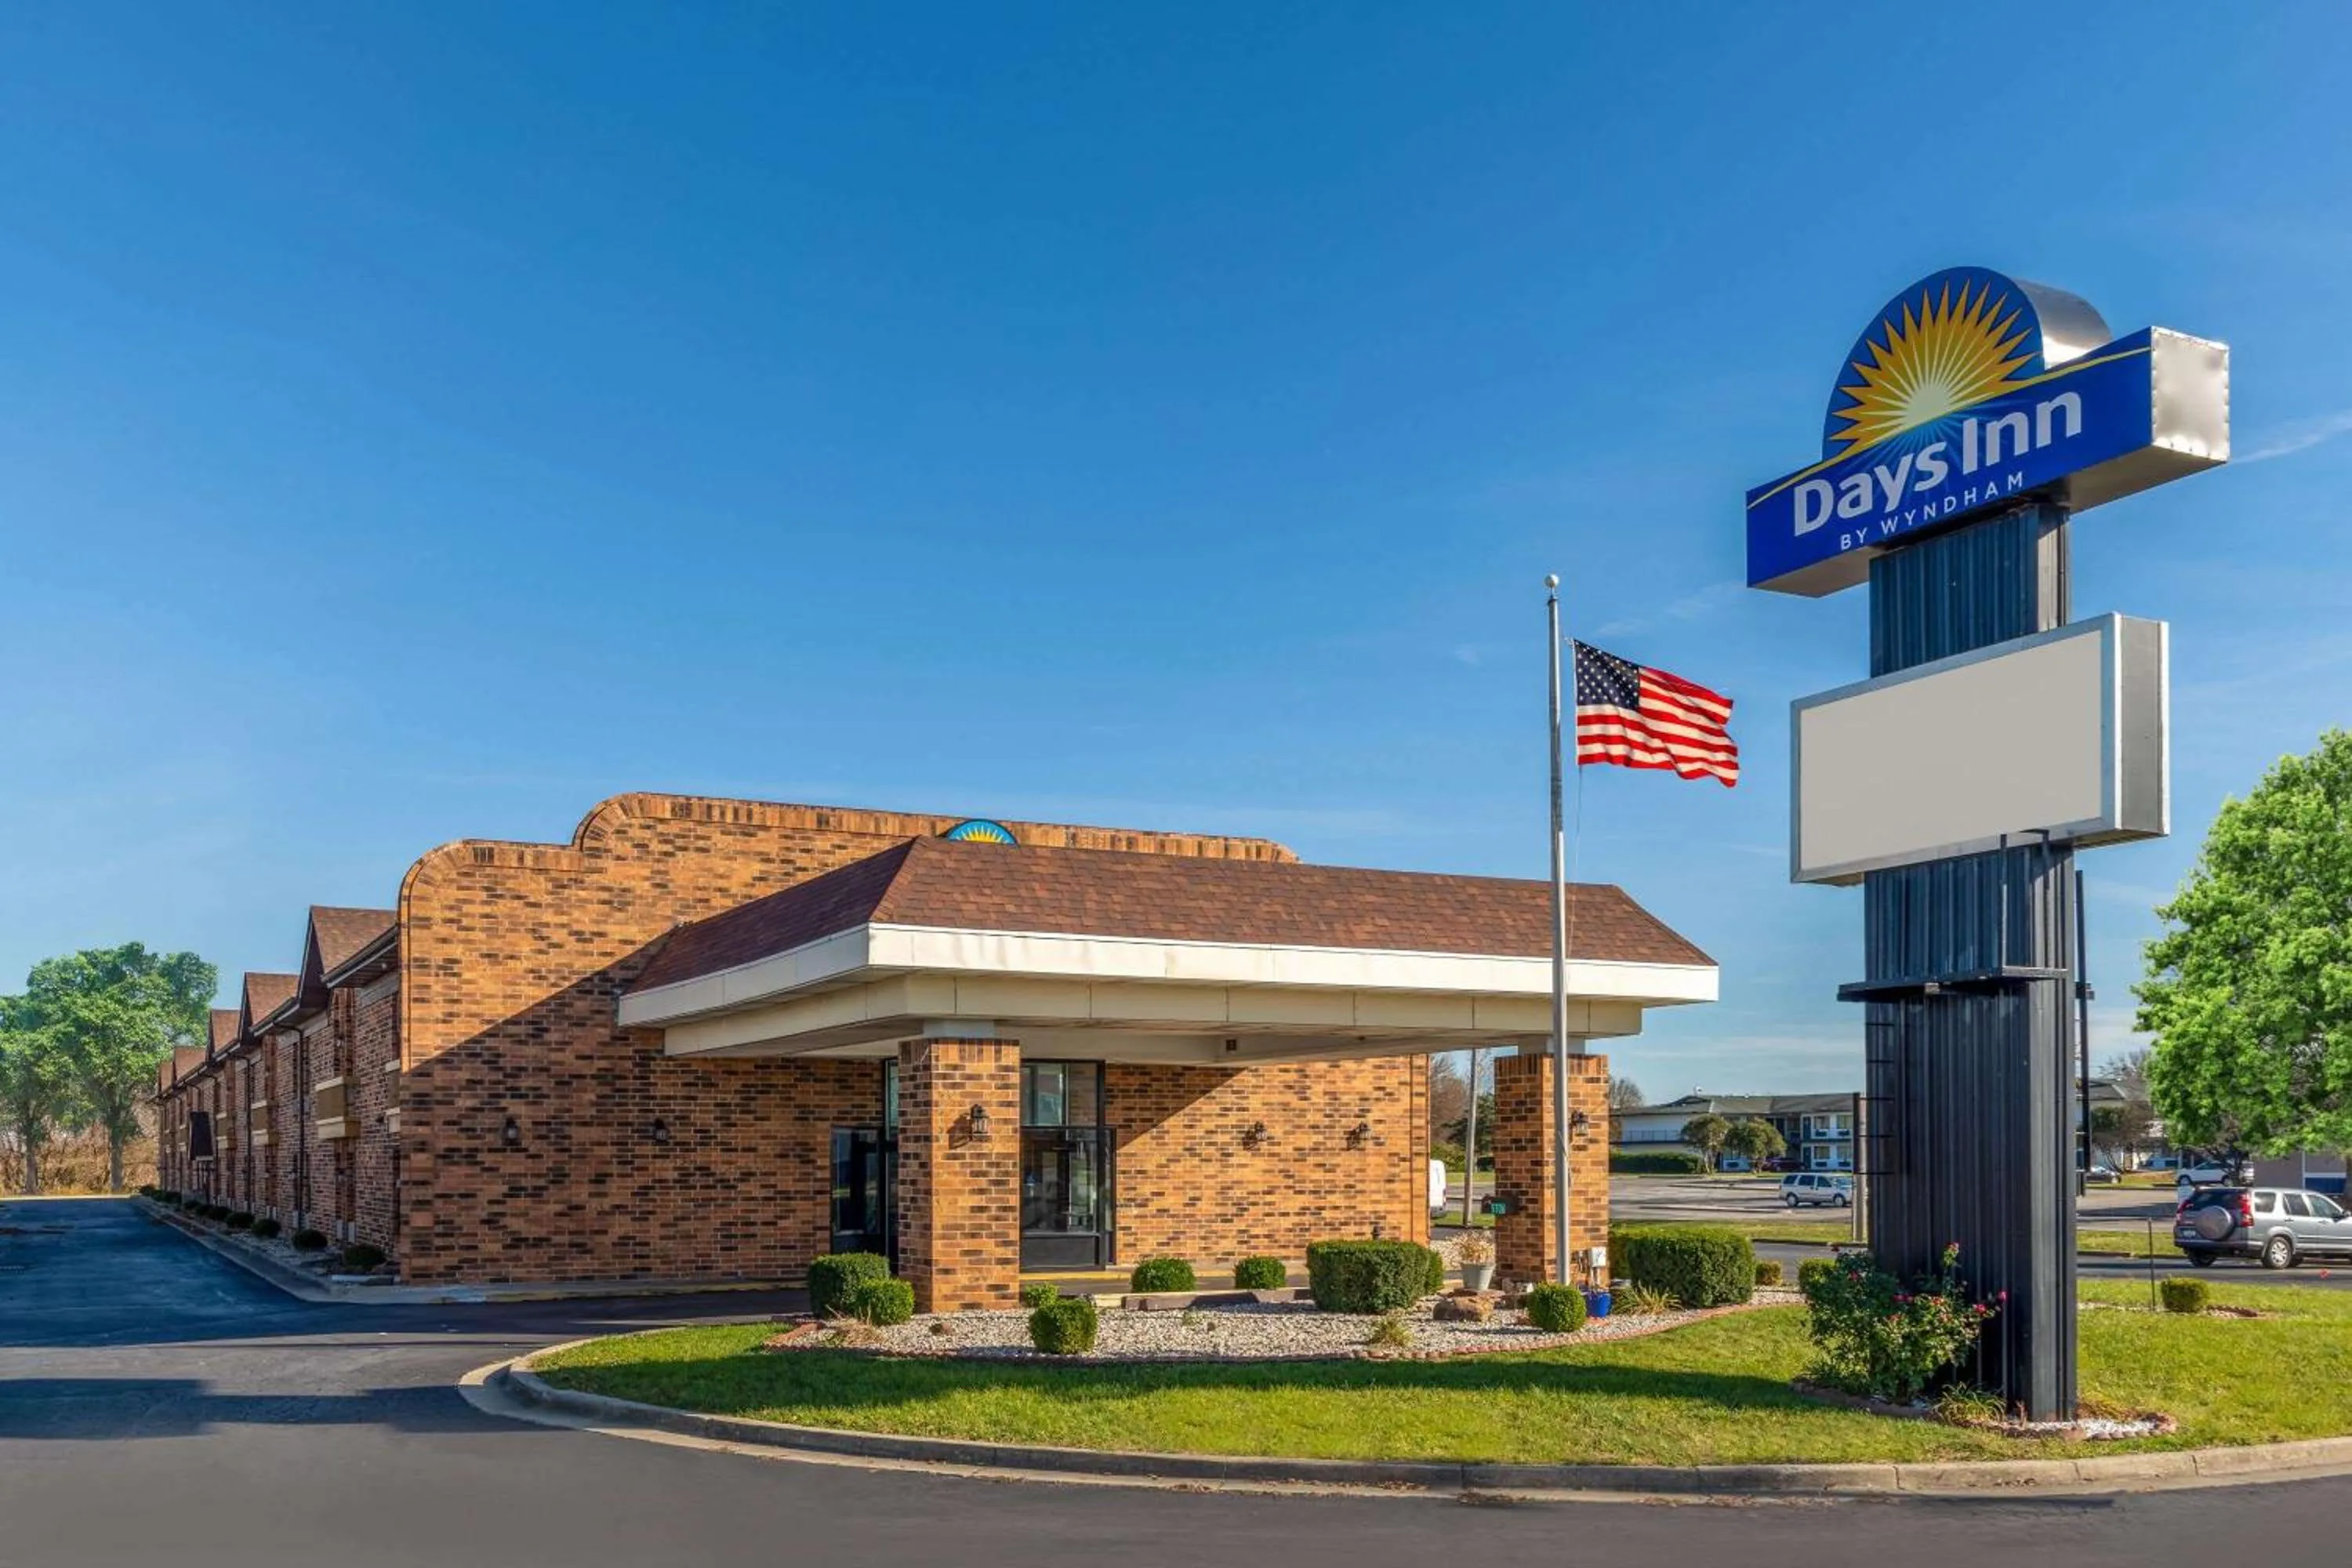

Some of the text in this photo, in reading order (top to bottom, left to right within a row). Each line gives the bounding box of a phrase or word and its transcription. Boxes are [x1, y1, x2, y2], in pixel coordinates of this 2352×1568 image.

[1794, 391, 2082, 537] Days Inn
[1840, 470, 2024, 551] BY WYNDHAM
